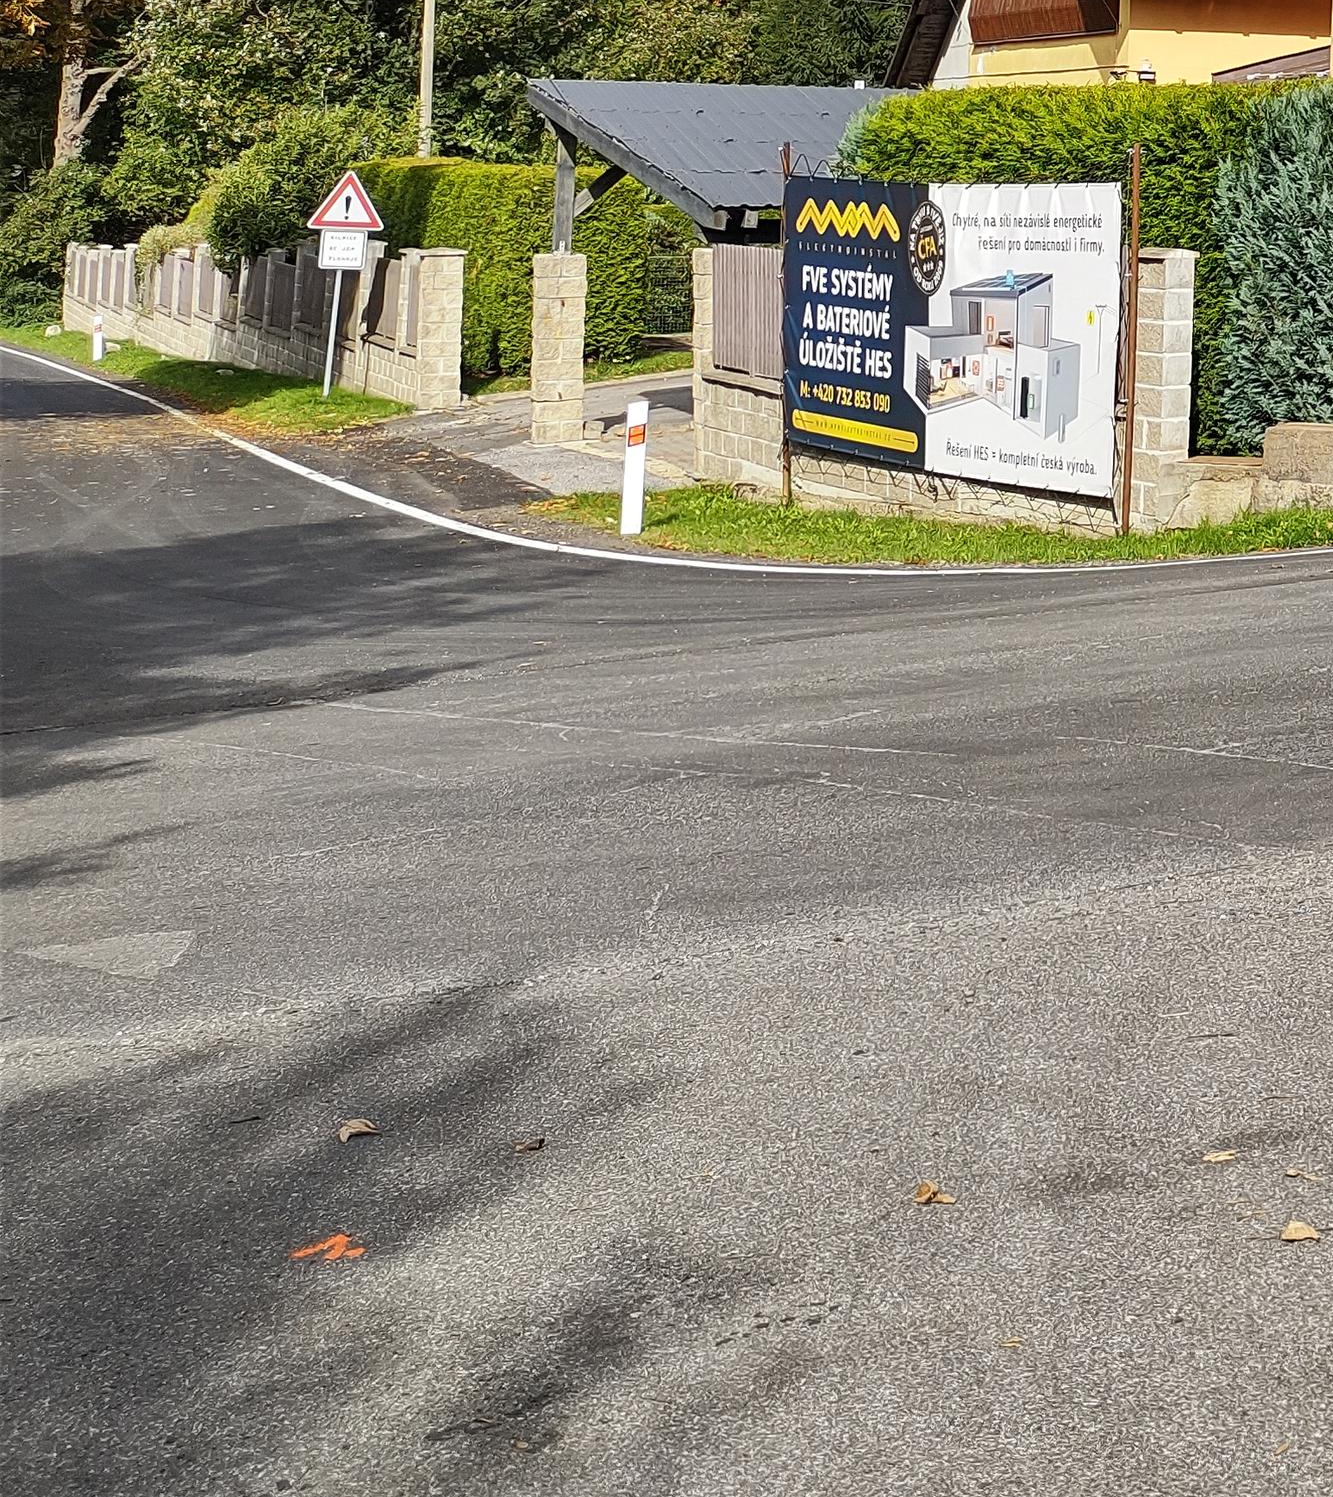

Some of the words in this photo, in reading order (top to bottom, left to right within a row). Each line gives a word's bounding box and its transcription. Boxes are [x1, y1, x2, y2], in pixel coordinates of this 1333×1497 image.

[952, 212, 981, 231] Chytré,
[983, 217, 997, 228] na
[999, 213, 1011, 228] síti
[1013, 213, 1050, 228] nezávislé
[1053, 214, 1103, 232] energetické
[978, 236, 1006, 250] řešení
[1008, 240, 1021, 254] pro
[1024, 237, 1071, 252] domácnosti
[802, 265, 827, 293] FVE
[831, 263, 893, 302] SYSTÉMY
[802, 302, 813, 329] A
[816, 304, 891, 340] BATERIOVÉ
[799, 332, 862, 374] ÚLOŽIŠTĚ
[865, 348, 892, 379] HES
[800, 380, 811, 398] M:
[812, 383, 834, 402] +420
[836, 386, 853, 407] 732
[854, 390, 871, 409] 853
[873, 393, 890, 413] 090
[945, 438, 972, 459] Řešení
[974, 445, 989, 461] HES
[999, 448, 1039, 469] kompletní
[1041, 454, 1064, 471] česká
[1066, 457, 1098, 477] výroba.
